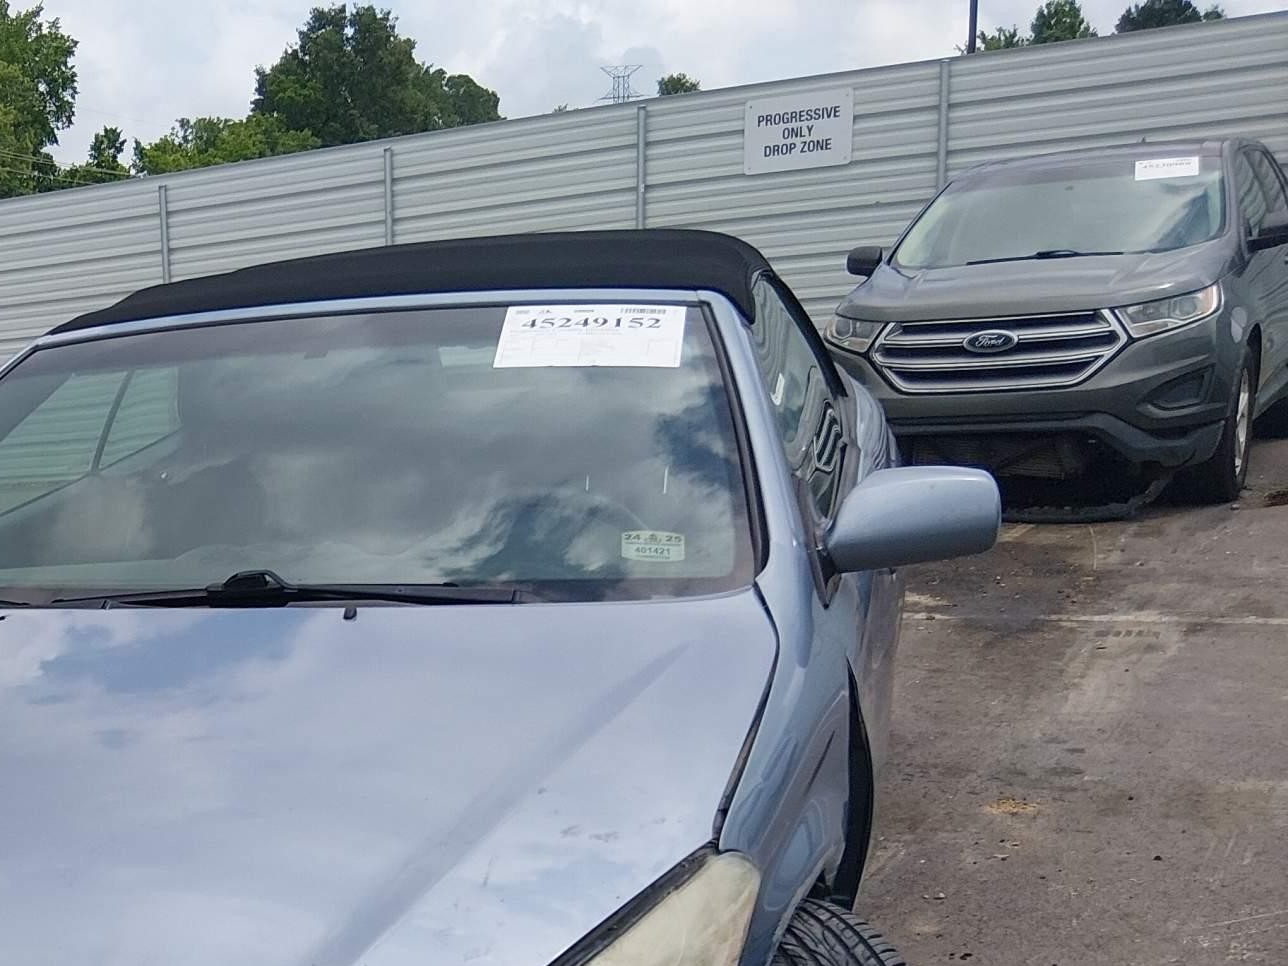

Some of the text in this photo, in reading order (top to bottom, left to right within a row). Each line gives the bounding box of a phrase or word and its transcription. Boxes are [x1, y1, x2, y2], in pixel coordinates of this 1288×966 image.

[757, 105, 841, 127] PROGRESSIVE
[782, 124, 814, 140] ONLY
[763, 138, 832, 157] DROP ZONE
[521, 317, 662, 329] 45249152
[975, 334, 1005, 347] Ford
